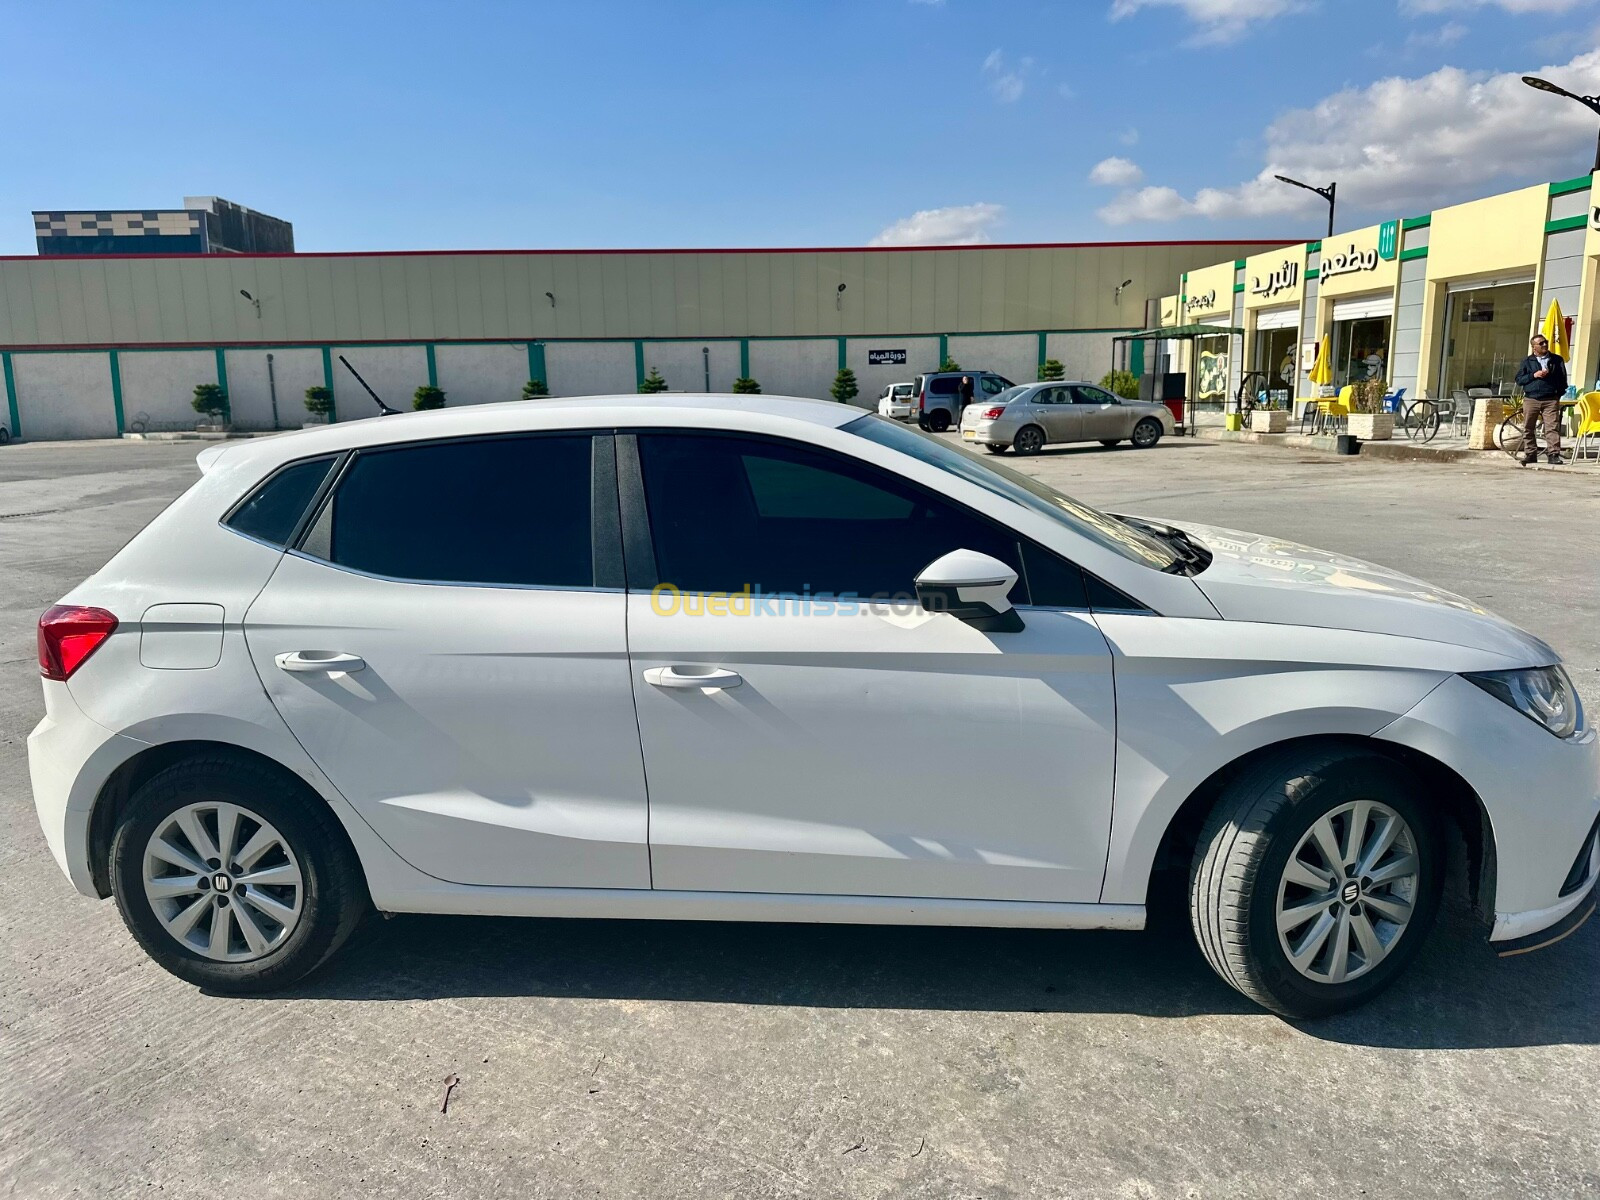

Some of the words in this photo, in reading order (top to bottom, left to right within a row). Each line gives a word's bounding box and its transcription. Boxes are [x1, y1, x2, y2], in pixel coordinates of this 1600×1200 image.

[1319, 244, 1378, 286] مطعم
[869, 351, 890, 361] المياه
[890, 351, 906, 361] دورة
